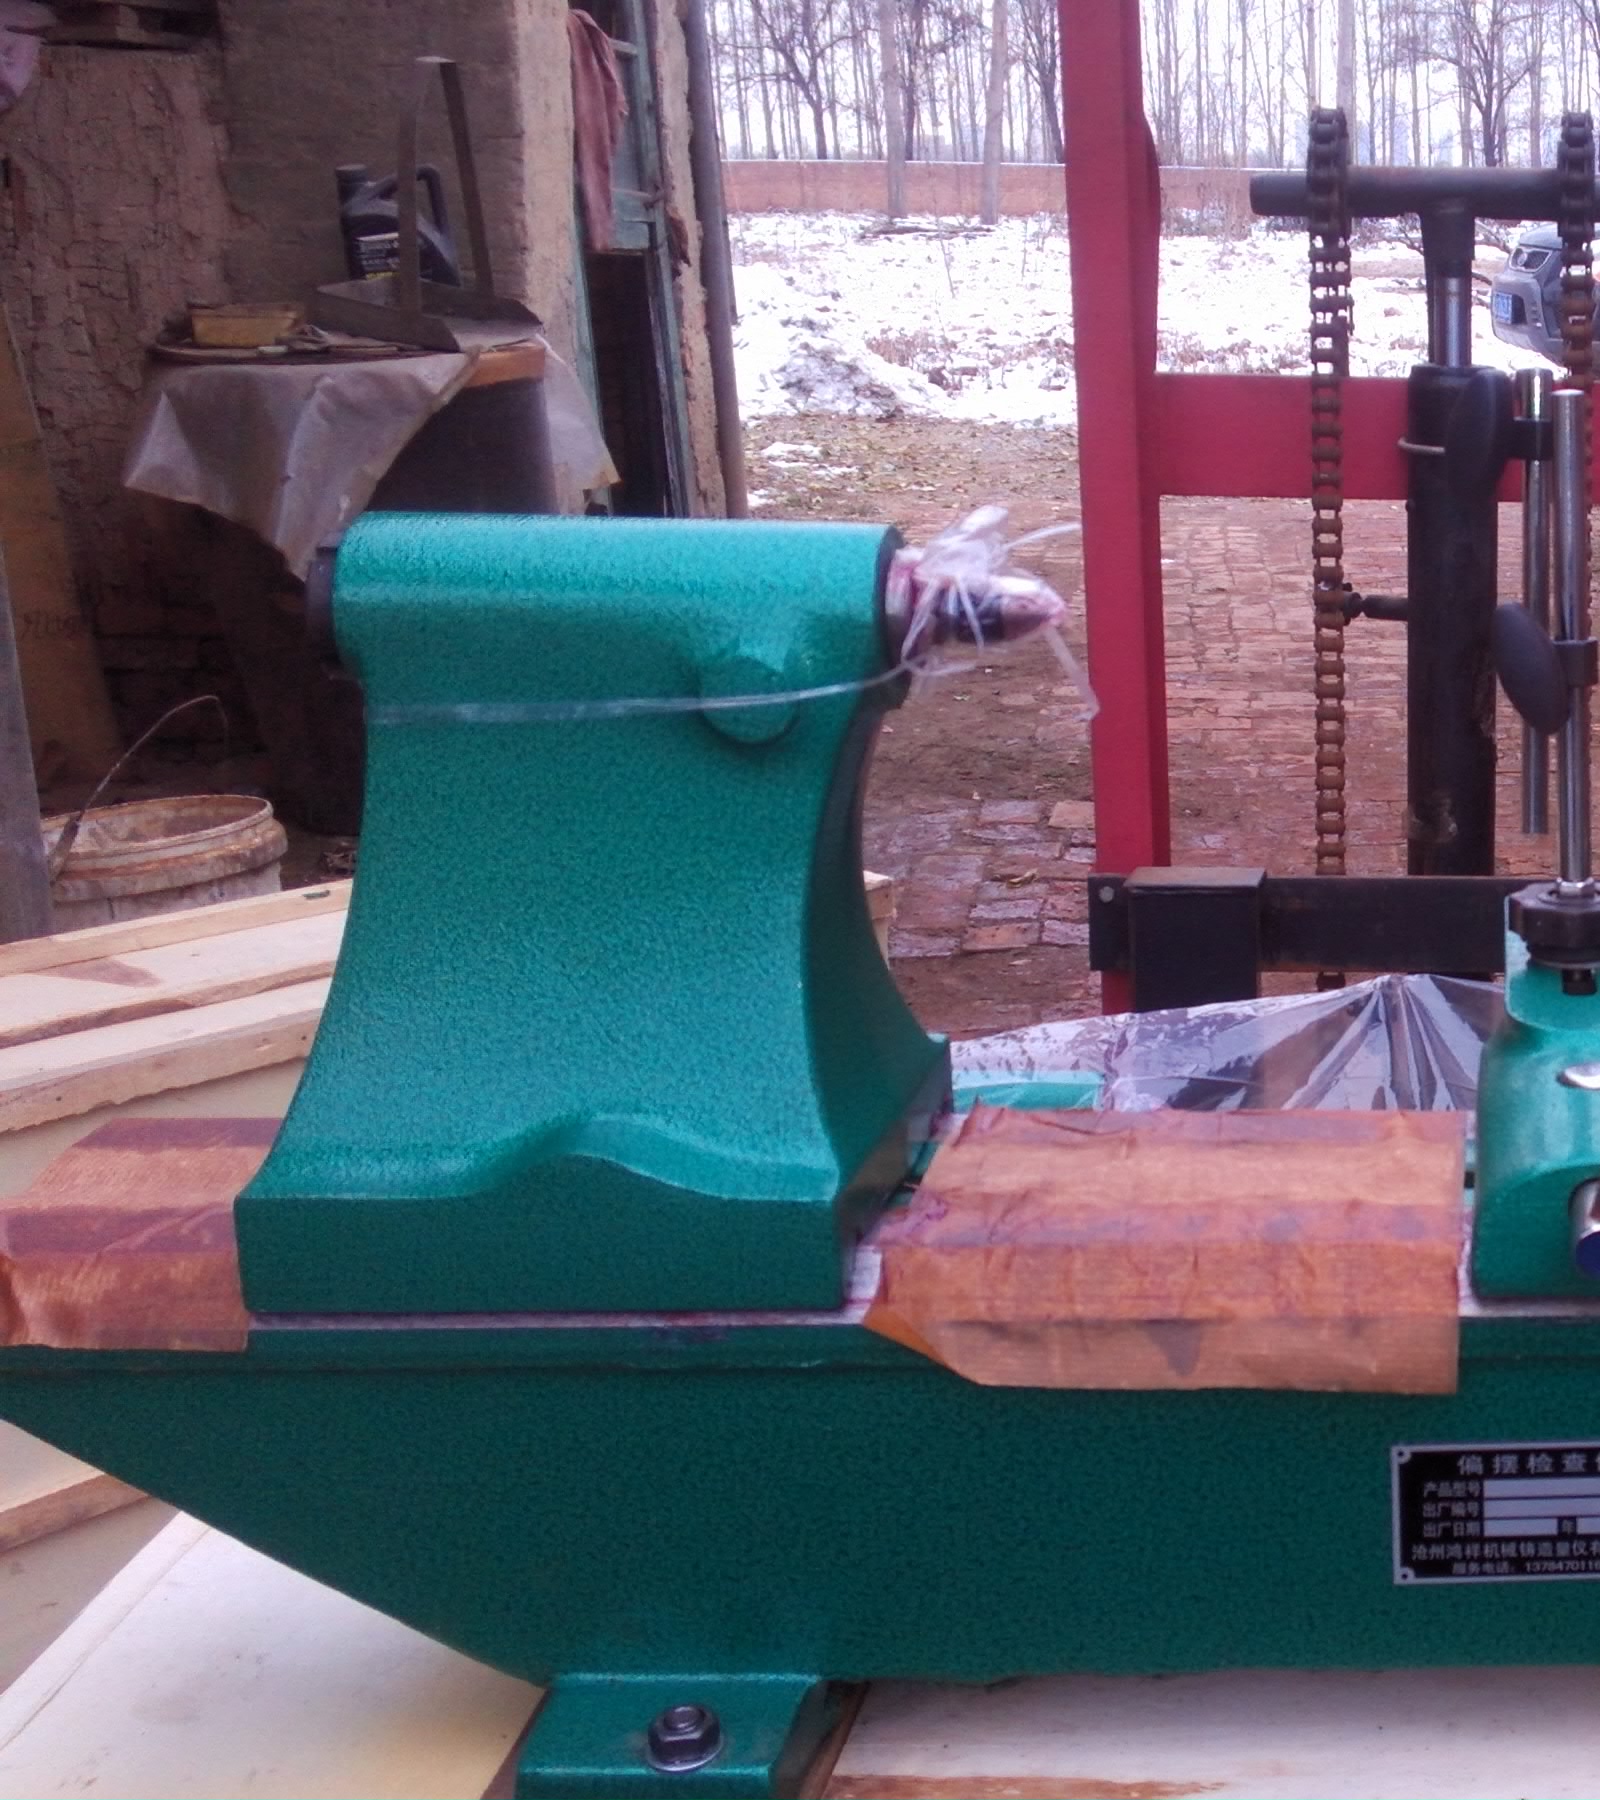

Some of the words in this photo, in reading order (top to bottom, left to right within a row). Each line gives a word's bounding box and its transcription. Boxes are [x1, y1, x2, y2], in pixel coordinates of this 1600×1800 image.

[1423, 1481, 1481, 1498] 产品型号
[1423, 1502, 1480, 1518] 出厂编号
[1423, 1521, 1480, 1537] 出厂日期
[1561, 1519, 1575, 1534] 年
